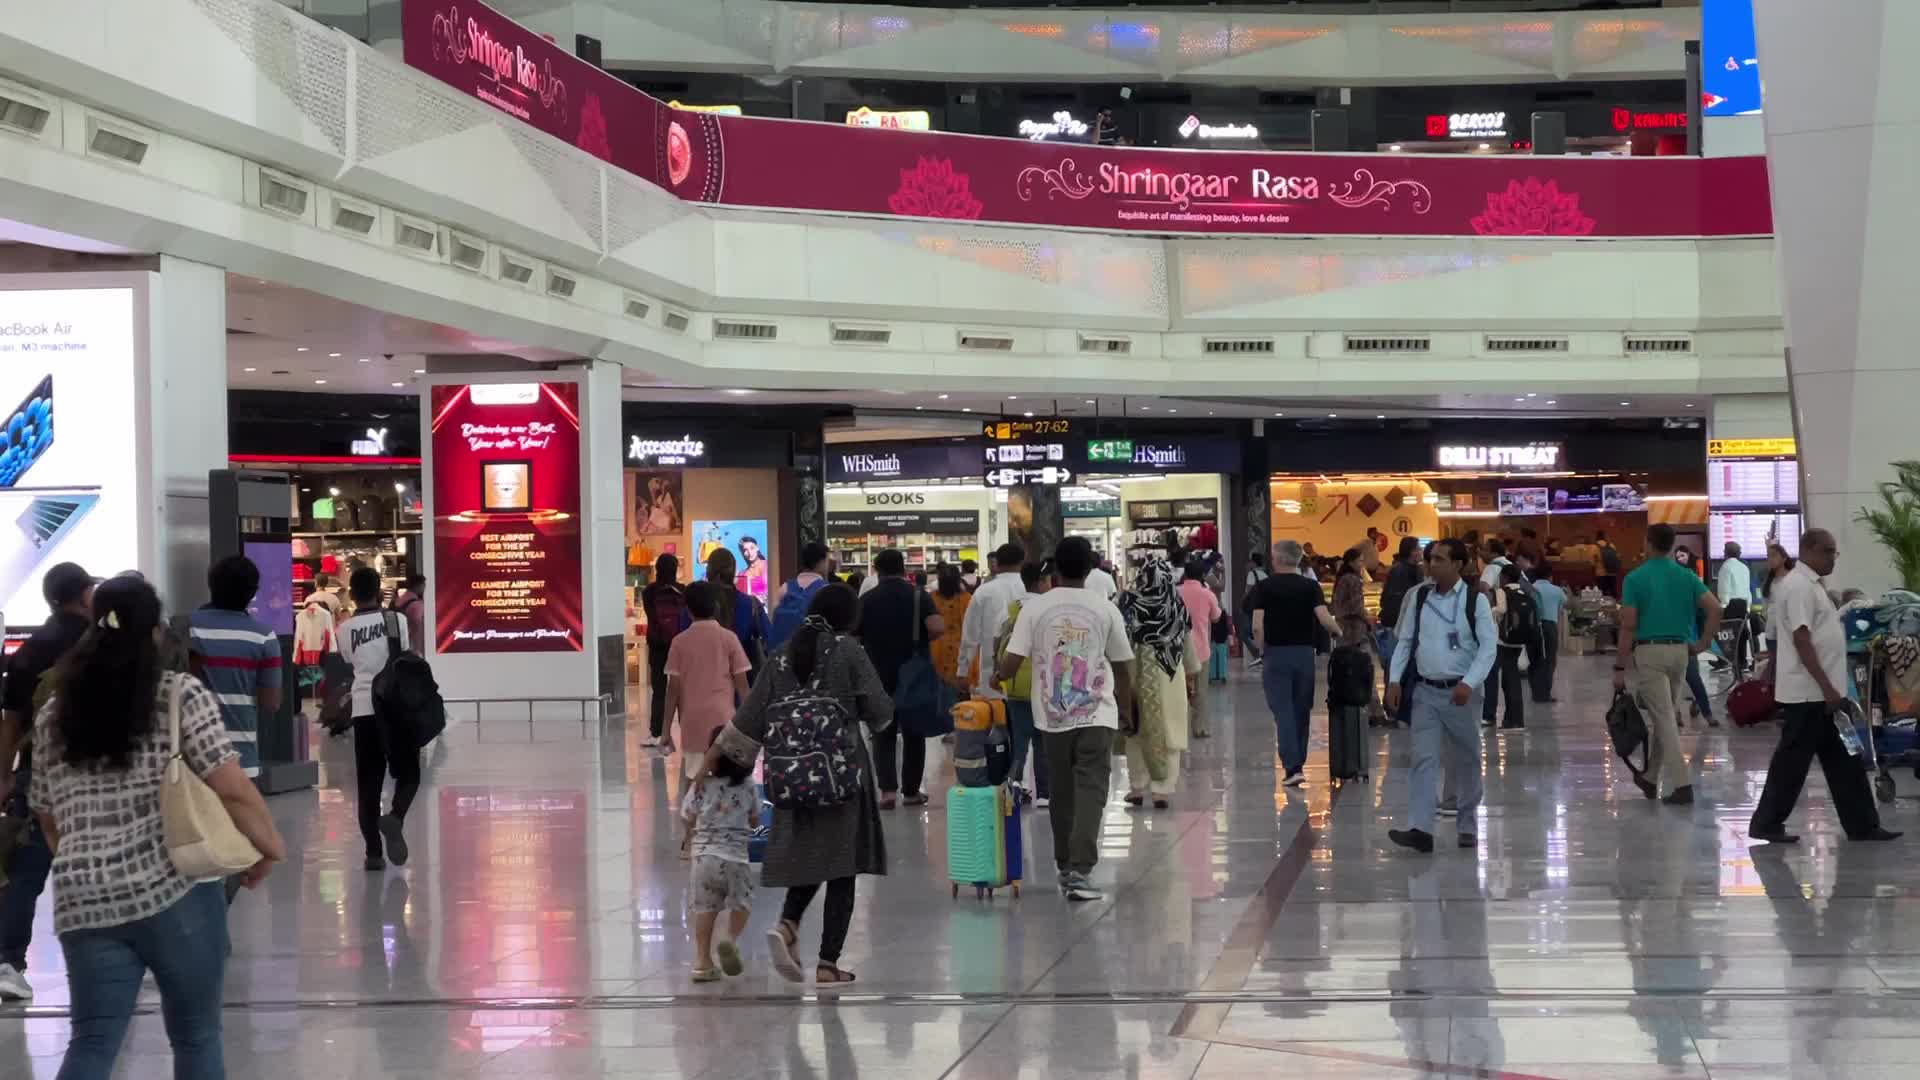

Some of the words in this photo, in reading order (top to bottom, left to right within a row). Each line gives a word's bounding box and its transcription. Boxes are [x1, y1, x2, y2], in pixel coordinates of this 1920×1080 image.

[467, 16, 514, 92] Shringaar
[517, 45, 537, 91] Rasa
[1099, 162, 1239, 210] Shringaar
[1252, 168, 1319, 199] Rasa
[1118, 211, 1148, 221] Exquisite
[1149, 212, 1160, 220] art
[1161, 212, 1169, 220] of
[1213, 213, 1241, 223] beauty,
[1242, 214, 1258, 222] love
[1259, 214, 1266, 222] &
[1267, 214, 1289, 223] desire
[54, 322, 72, 335] Air
[40, 341, 87, 352] machine
[628, 433, 704, 460] Accessorize
[1130, 444, 1186, 463] HSmith
[842, 453, 900, 472] WHSmith
[866, 492, 925, 505] BOOKS
[480, 534, 499, 542] BEST
[500, 533, 535, 542] AIRPORT
[485, 543, 501, 551] FOR
[502, 542, 519, 551] THE
[470, 551, 524, 560] CONSECUTIVE
[526, 551, 545, 559] YEAR
[471, 581, 510, 589] CLEANEST
[511, 580, 545, 589] AIRPORT
[486, 590, 502, 598] FOR
[471, 599, 524, 608] CONSECUTIVE
[526, 598, 546, 606] YEAR
